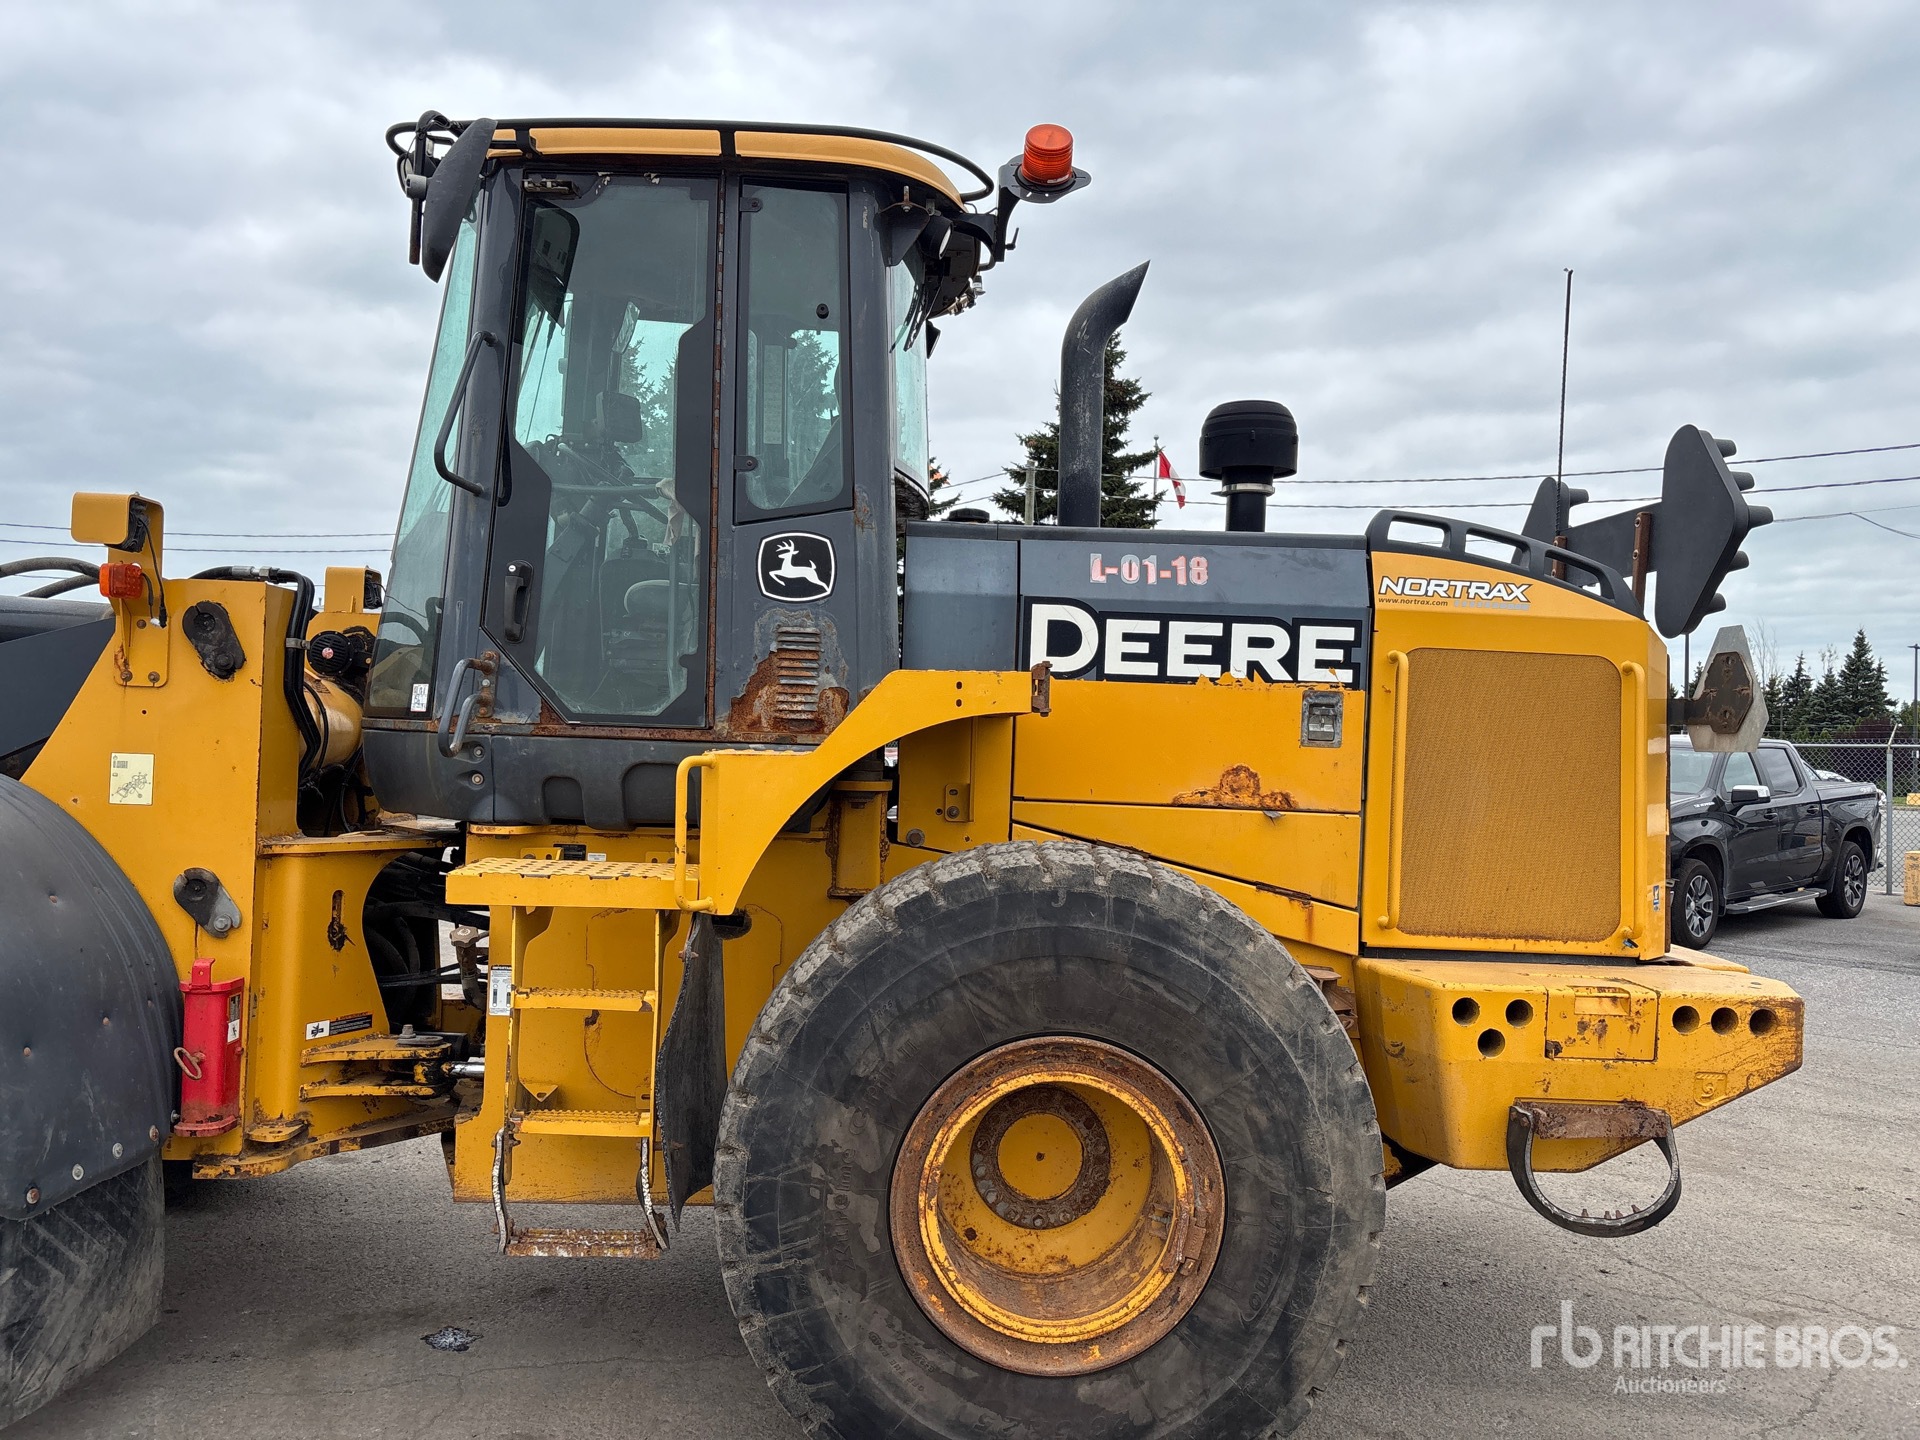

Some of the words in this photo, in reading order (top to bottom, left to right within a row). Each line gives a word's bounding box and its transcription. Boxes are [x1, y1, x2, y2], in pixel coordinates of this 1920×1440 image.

[1090, 553, 1208, 585] L-01-18
[1378, 597, 1448, 607] www.nortrax.com
[1379, 576, 1533, 603] NORTRAX
[1030, 603, 1356, 681] DEERE
